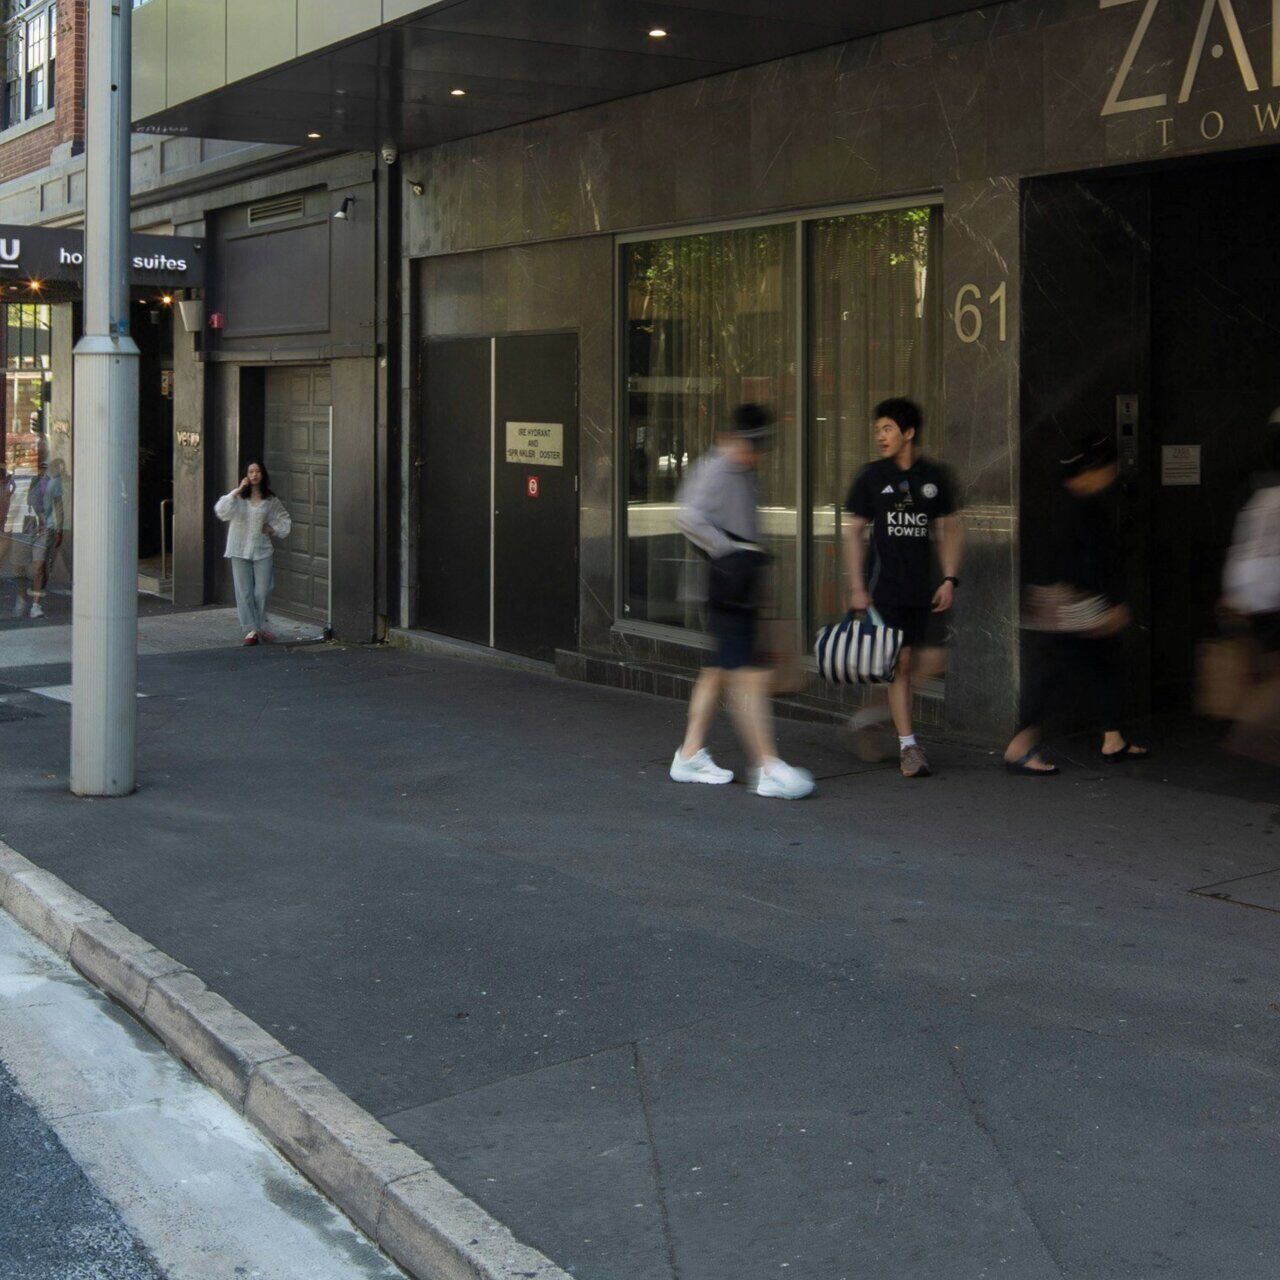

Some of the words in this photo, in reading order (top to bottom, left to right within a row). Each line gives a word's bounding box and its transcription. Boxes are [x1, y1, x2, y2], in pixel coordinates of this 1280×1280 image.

[132, 254, 187, 270] suites
[954, 282, 1006, 343] 61
[527, 439, 539, 447] AND
[507, 448, 536, 458] SPRNKLER
[539, 450, 561, 460] OOSTER
[887, 512, 928, 526] KING
[888, 526, 927, 537] POWER
